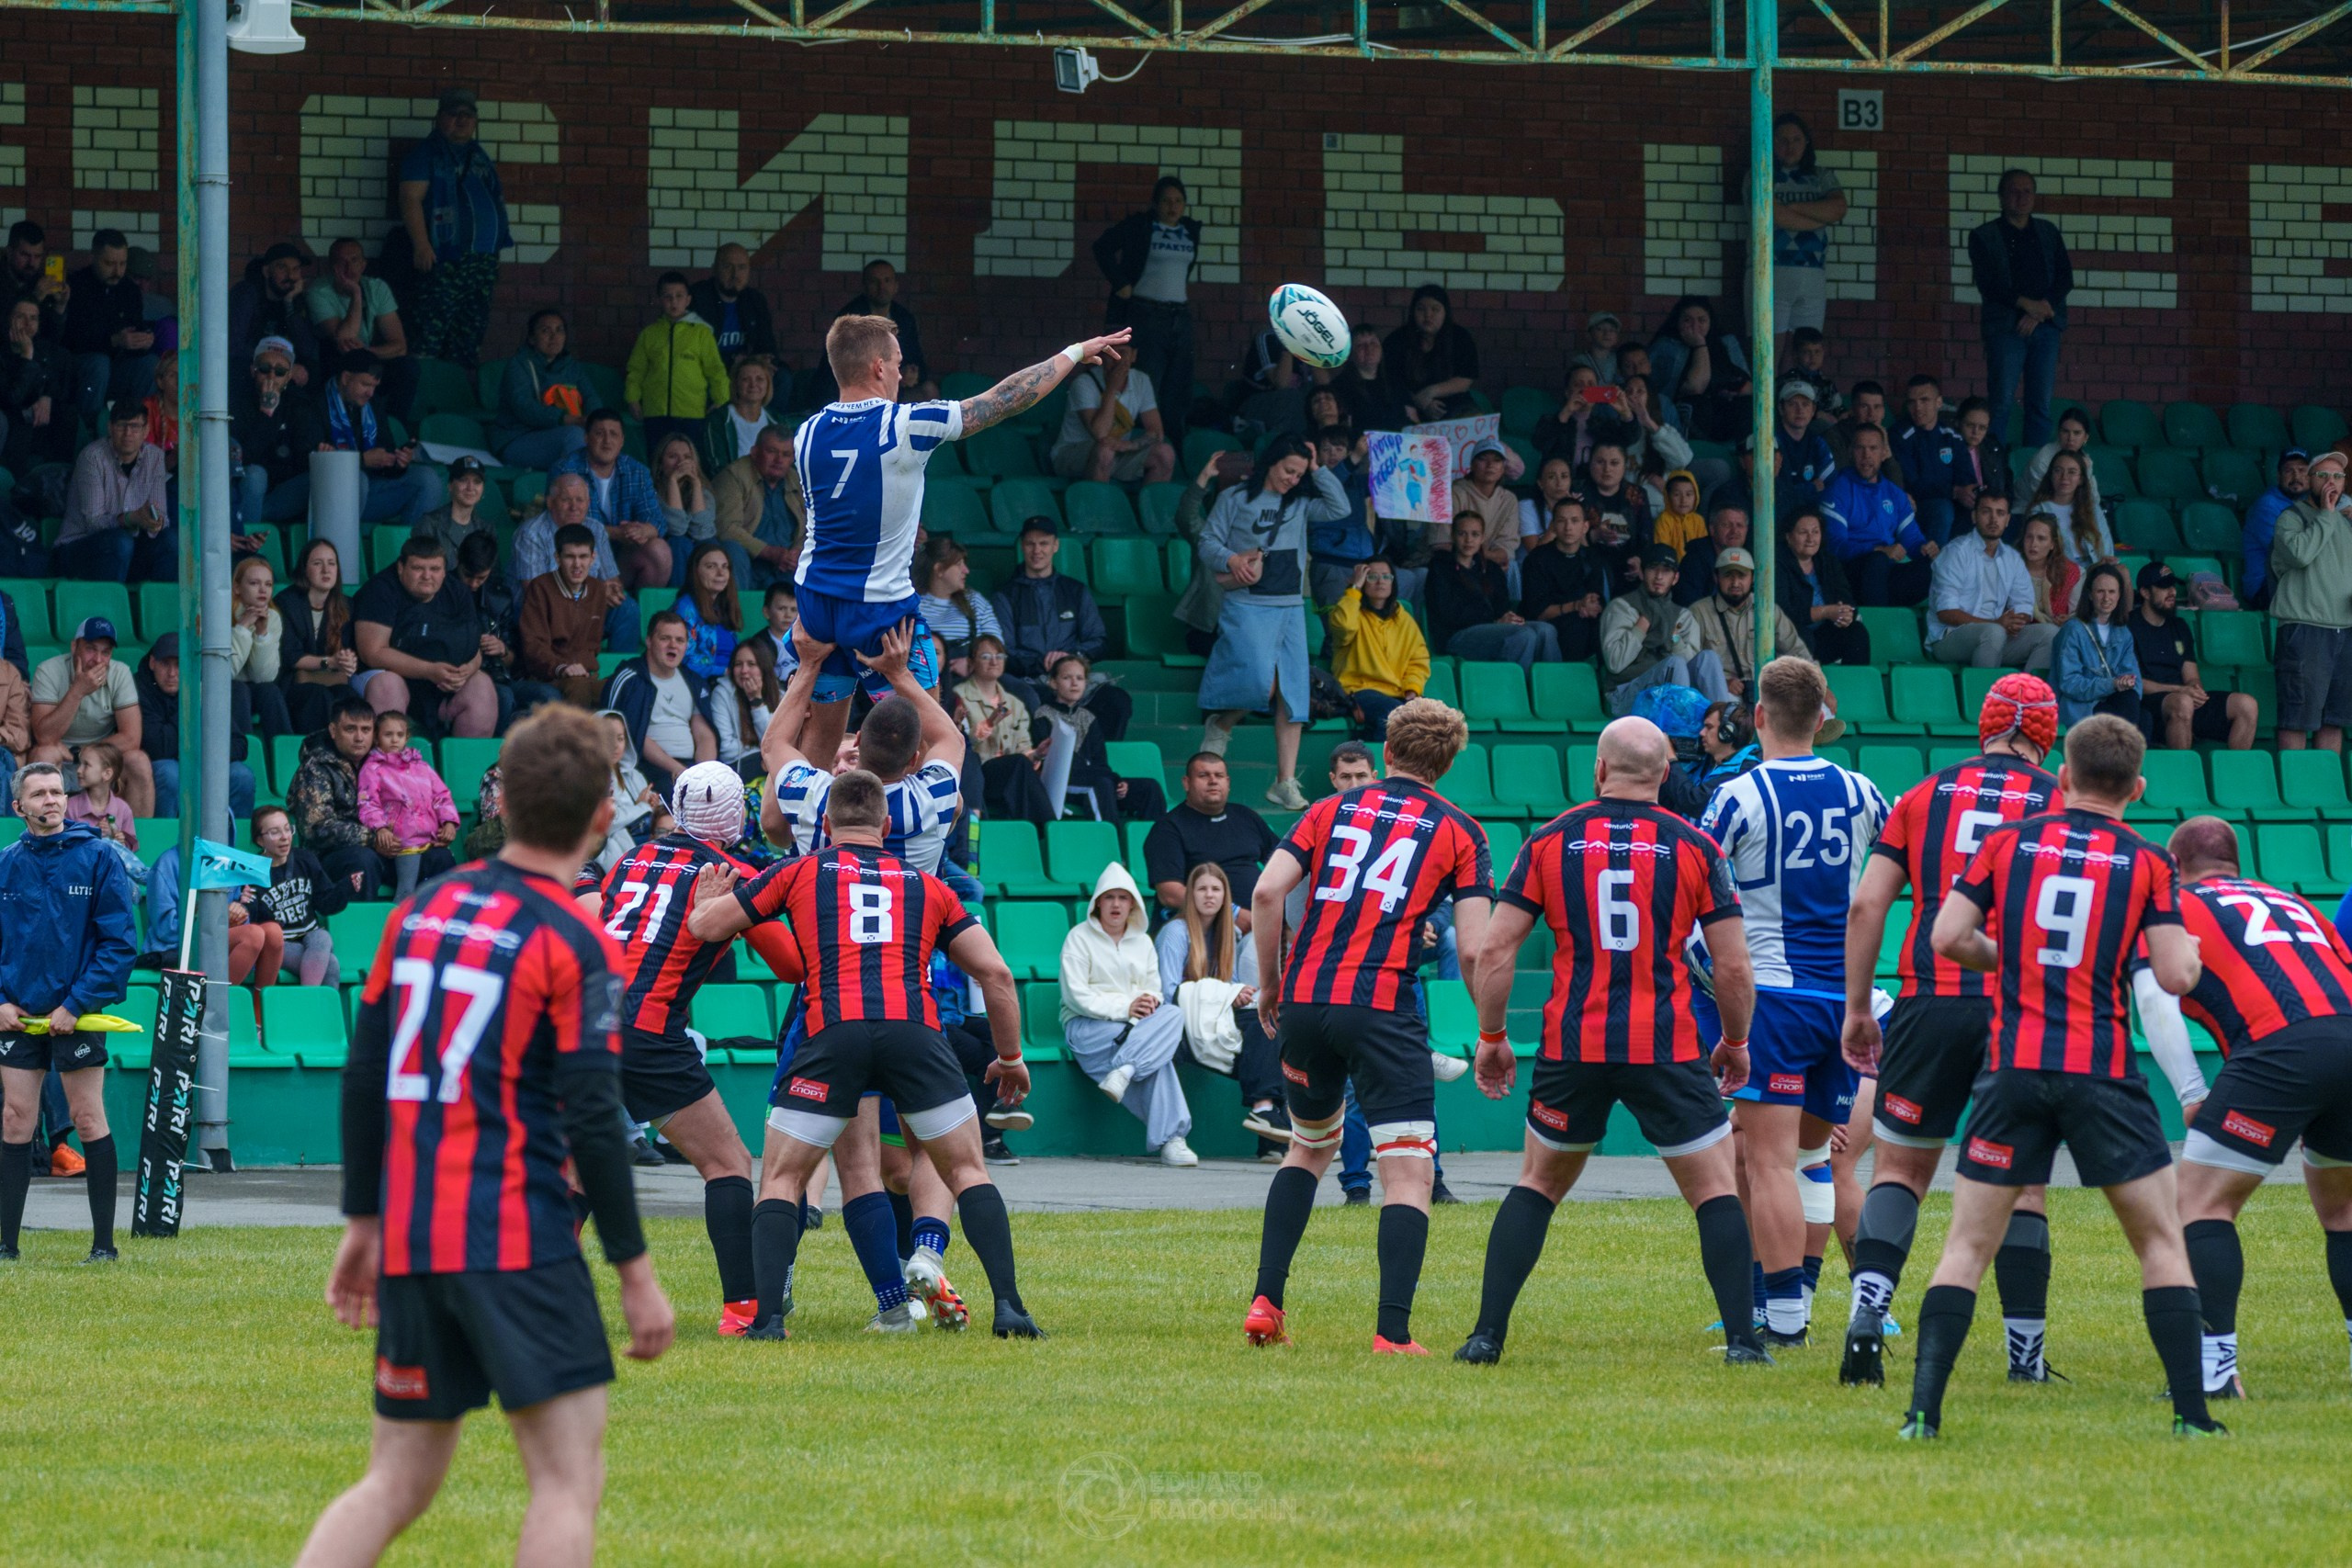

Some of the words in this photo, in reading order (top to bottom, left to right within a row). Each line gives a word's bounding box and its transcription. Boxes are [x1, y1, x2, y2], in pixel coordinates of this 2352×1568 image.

[1152, 243, 1193, 253] ТРАКТО
[1296, 309, 1334, 349] JÖGEL
[831, 448, 858, 499] 7
[1259, 509, 1279, 522] NIK
[1378, 795, 1411, 806] centurion
[1315, 825, 1419, 913] 34
[1784, 807, 1849, 869] 25
[604, 881, 673, 943] 21
[849, 883, 892, 943] 8
[1597, 868, 1639, 951] 6
[2035, 874, 2096, 968] 9
[2216, 895, 2332, 950] 23
[157, 976, 172, 1042] PARI
[180, 979, 201, 1044] PARI
[387, 958, 503, 1103] 27
[147, 1066, 162, 1132] PARI
[170, 1069, 190, 1134] PARI
[790, 1085, 826, 1099] СПОРТ
[1770, 1082, 1803, 1091] СПОРТ
[1533, 1108, 1566, 1128] СПОРТ
[2225, 1120, 2271, 1143] СПОРТ
[138, 1157, 152, 1223] PARI
[161, 1159, 181, 1224] PARI
